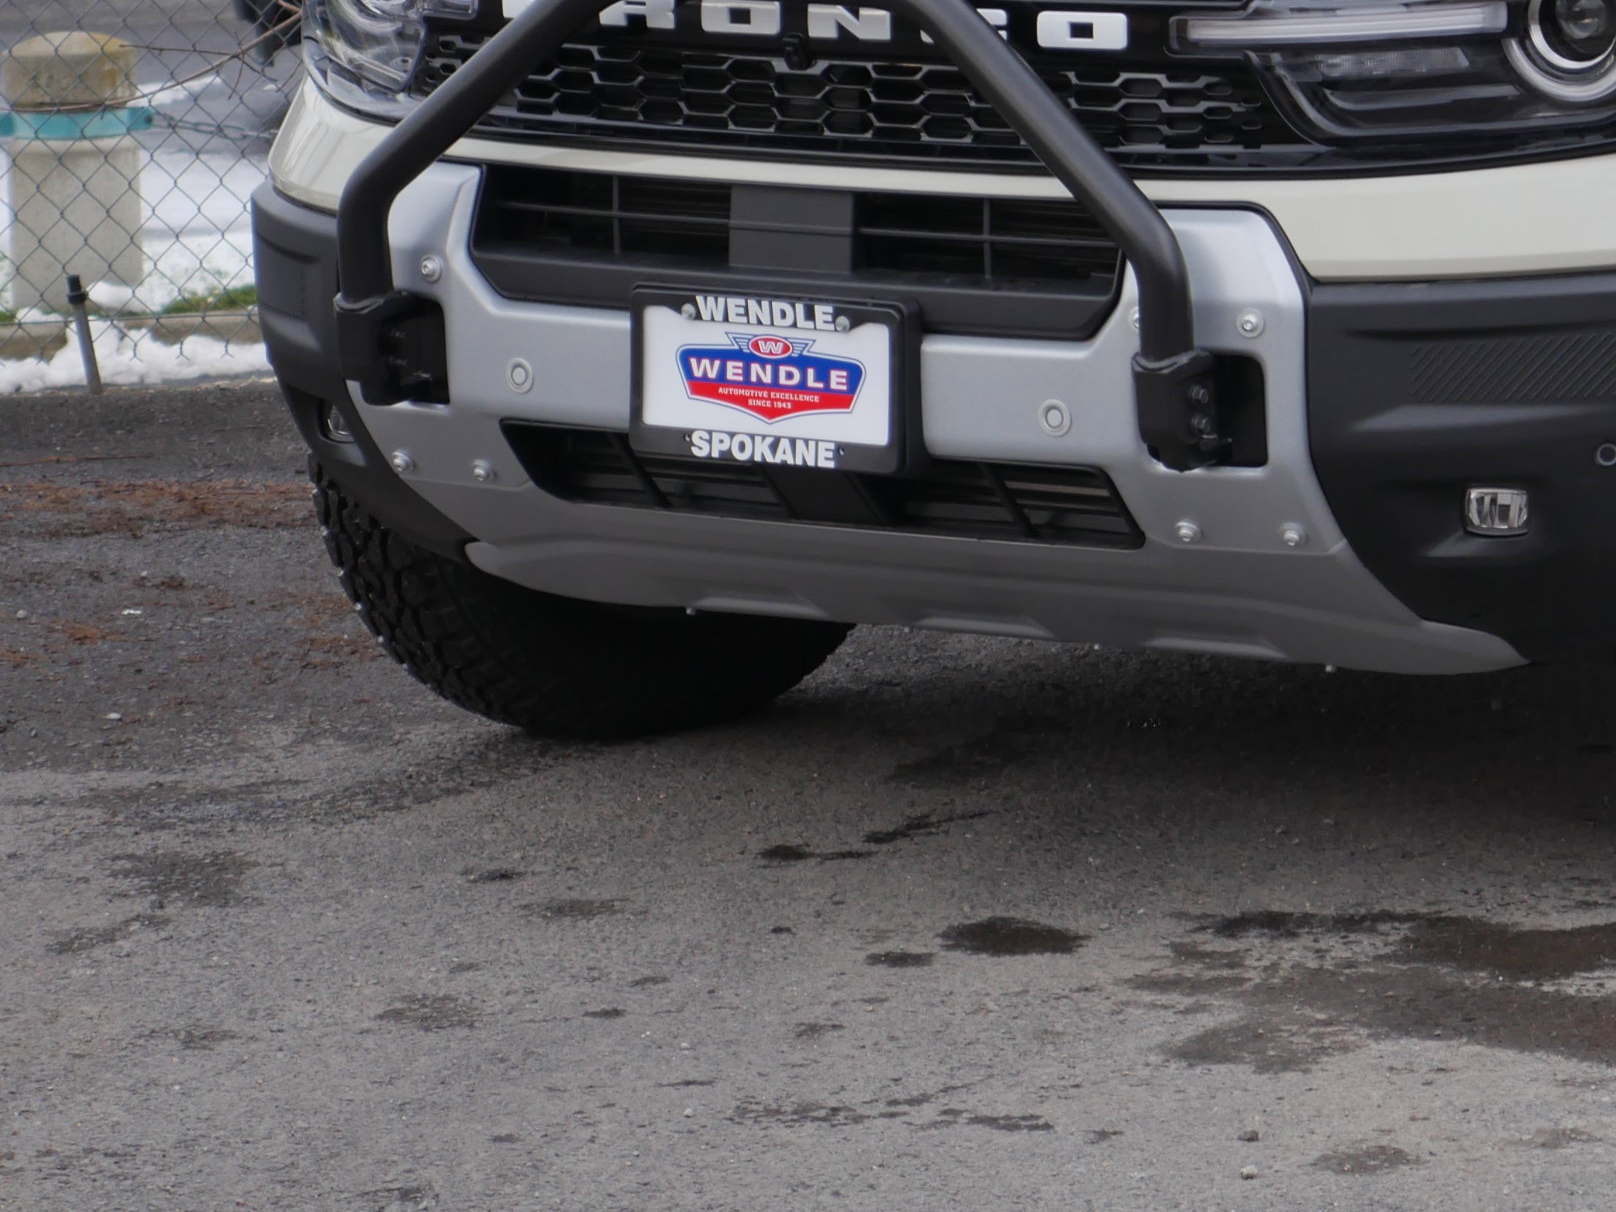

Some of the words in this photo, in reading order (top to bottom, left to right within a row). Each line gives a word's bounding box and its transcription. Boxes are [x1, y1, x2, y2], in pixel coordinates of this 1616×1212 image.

[696, 295, 835, 330] WENDLE
[690, 358, 848, 390] WENDLE
[718, 387, 768, 398] AUTOMOTIVE
[770, 392, 820, 403] EXCELLENCE
[748, 399, 772, 408] SINCE
[773, 401, 791, 409] 1943
[691, 431, 835, 468] SPOKANE
